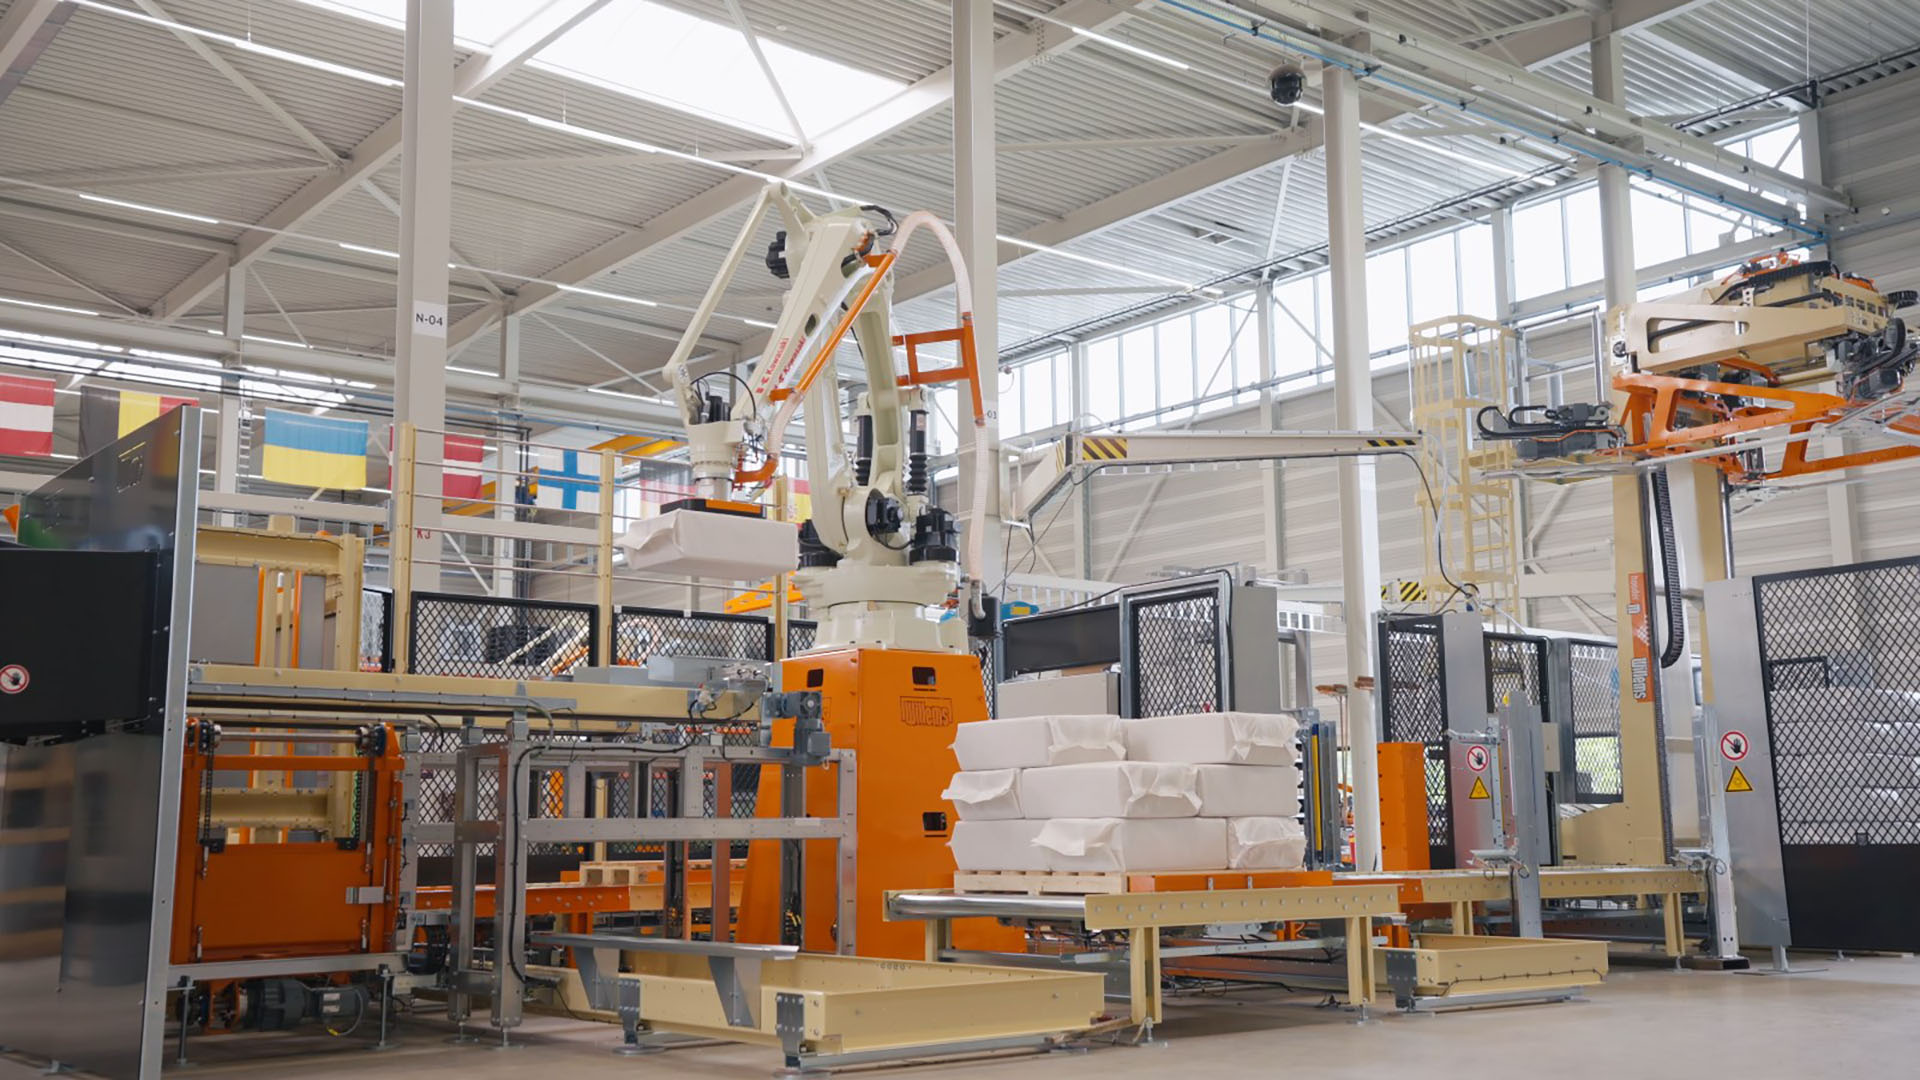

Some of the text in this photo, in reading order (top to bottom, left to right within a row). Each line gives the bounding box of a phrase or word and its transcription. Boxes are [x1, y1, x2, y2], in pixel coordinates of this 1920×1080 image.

[416, 313, 443, 326] N-04
[1632, 658, 1648, 699] Willems
[901, 700, 949, 727] Willems
